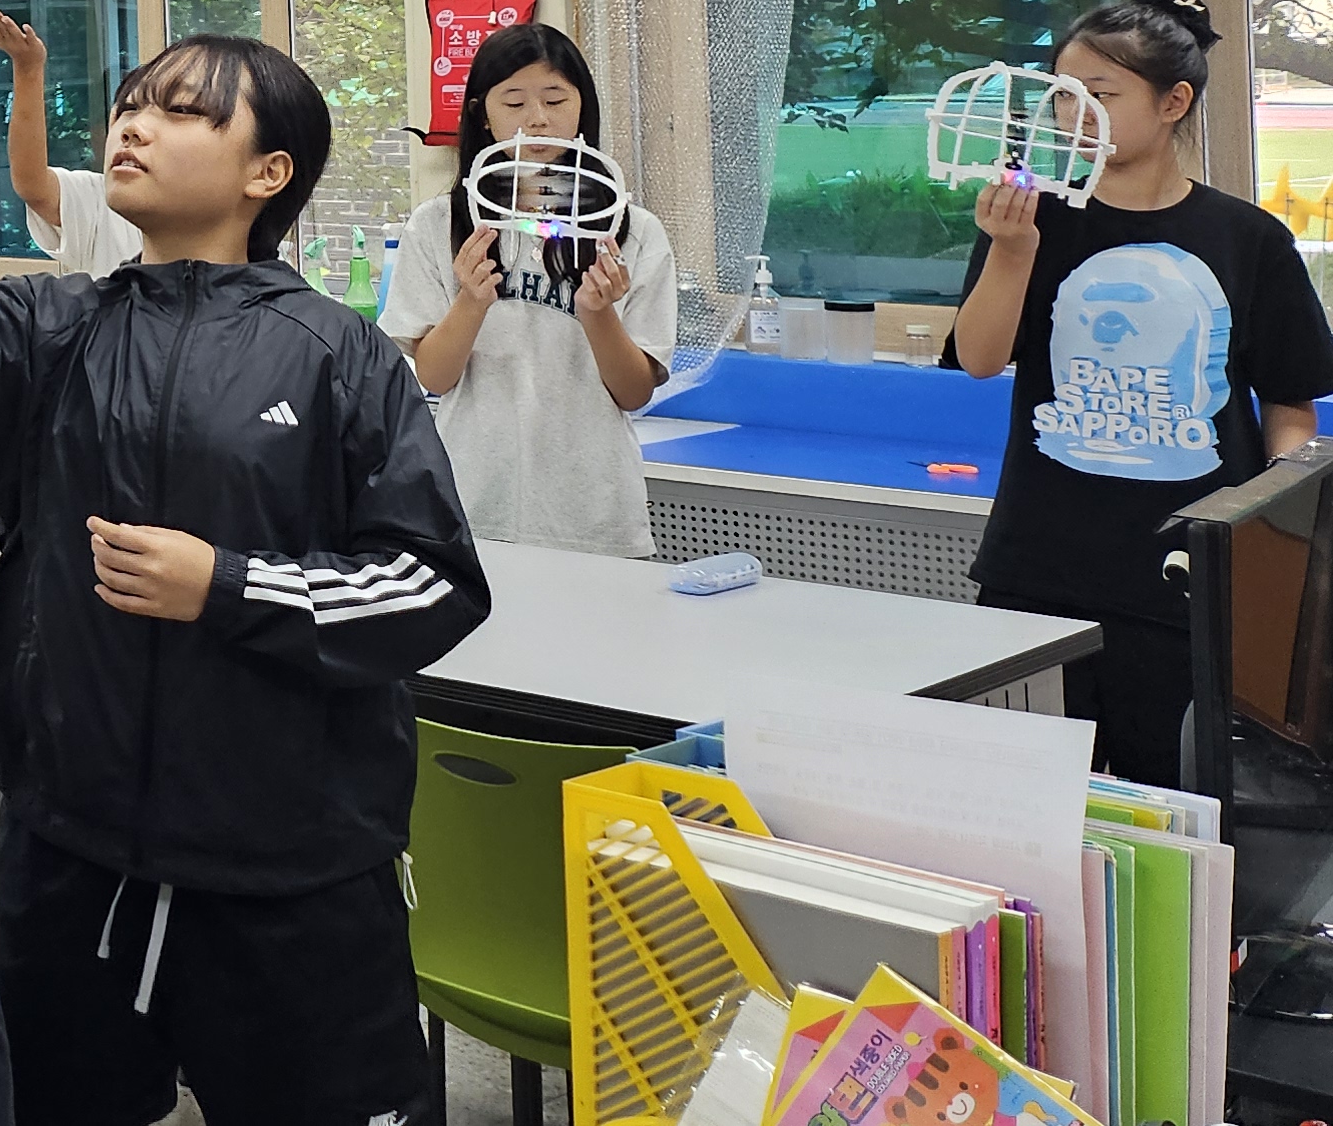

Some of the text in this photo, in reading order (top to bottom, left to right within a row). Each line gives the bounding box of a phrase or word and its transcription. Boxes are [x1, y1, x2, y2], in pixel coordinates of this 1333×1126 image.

[1068, 357, 1170, 394] BAPE
[1033, 403, 1211, 451] SAPPORO
[848, 1028, 893, 1077] 색종이
[866, 1044, 903, 1089] DOUBLE SIDED
